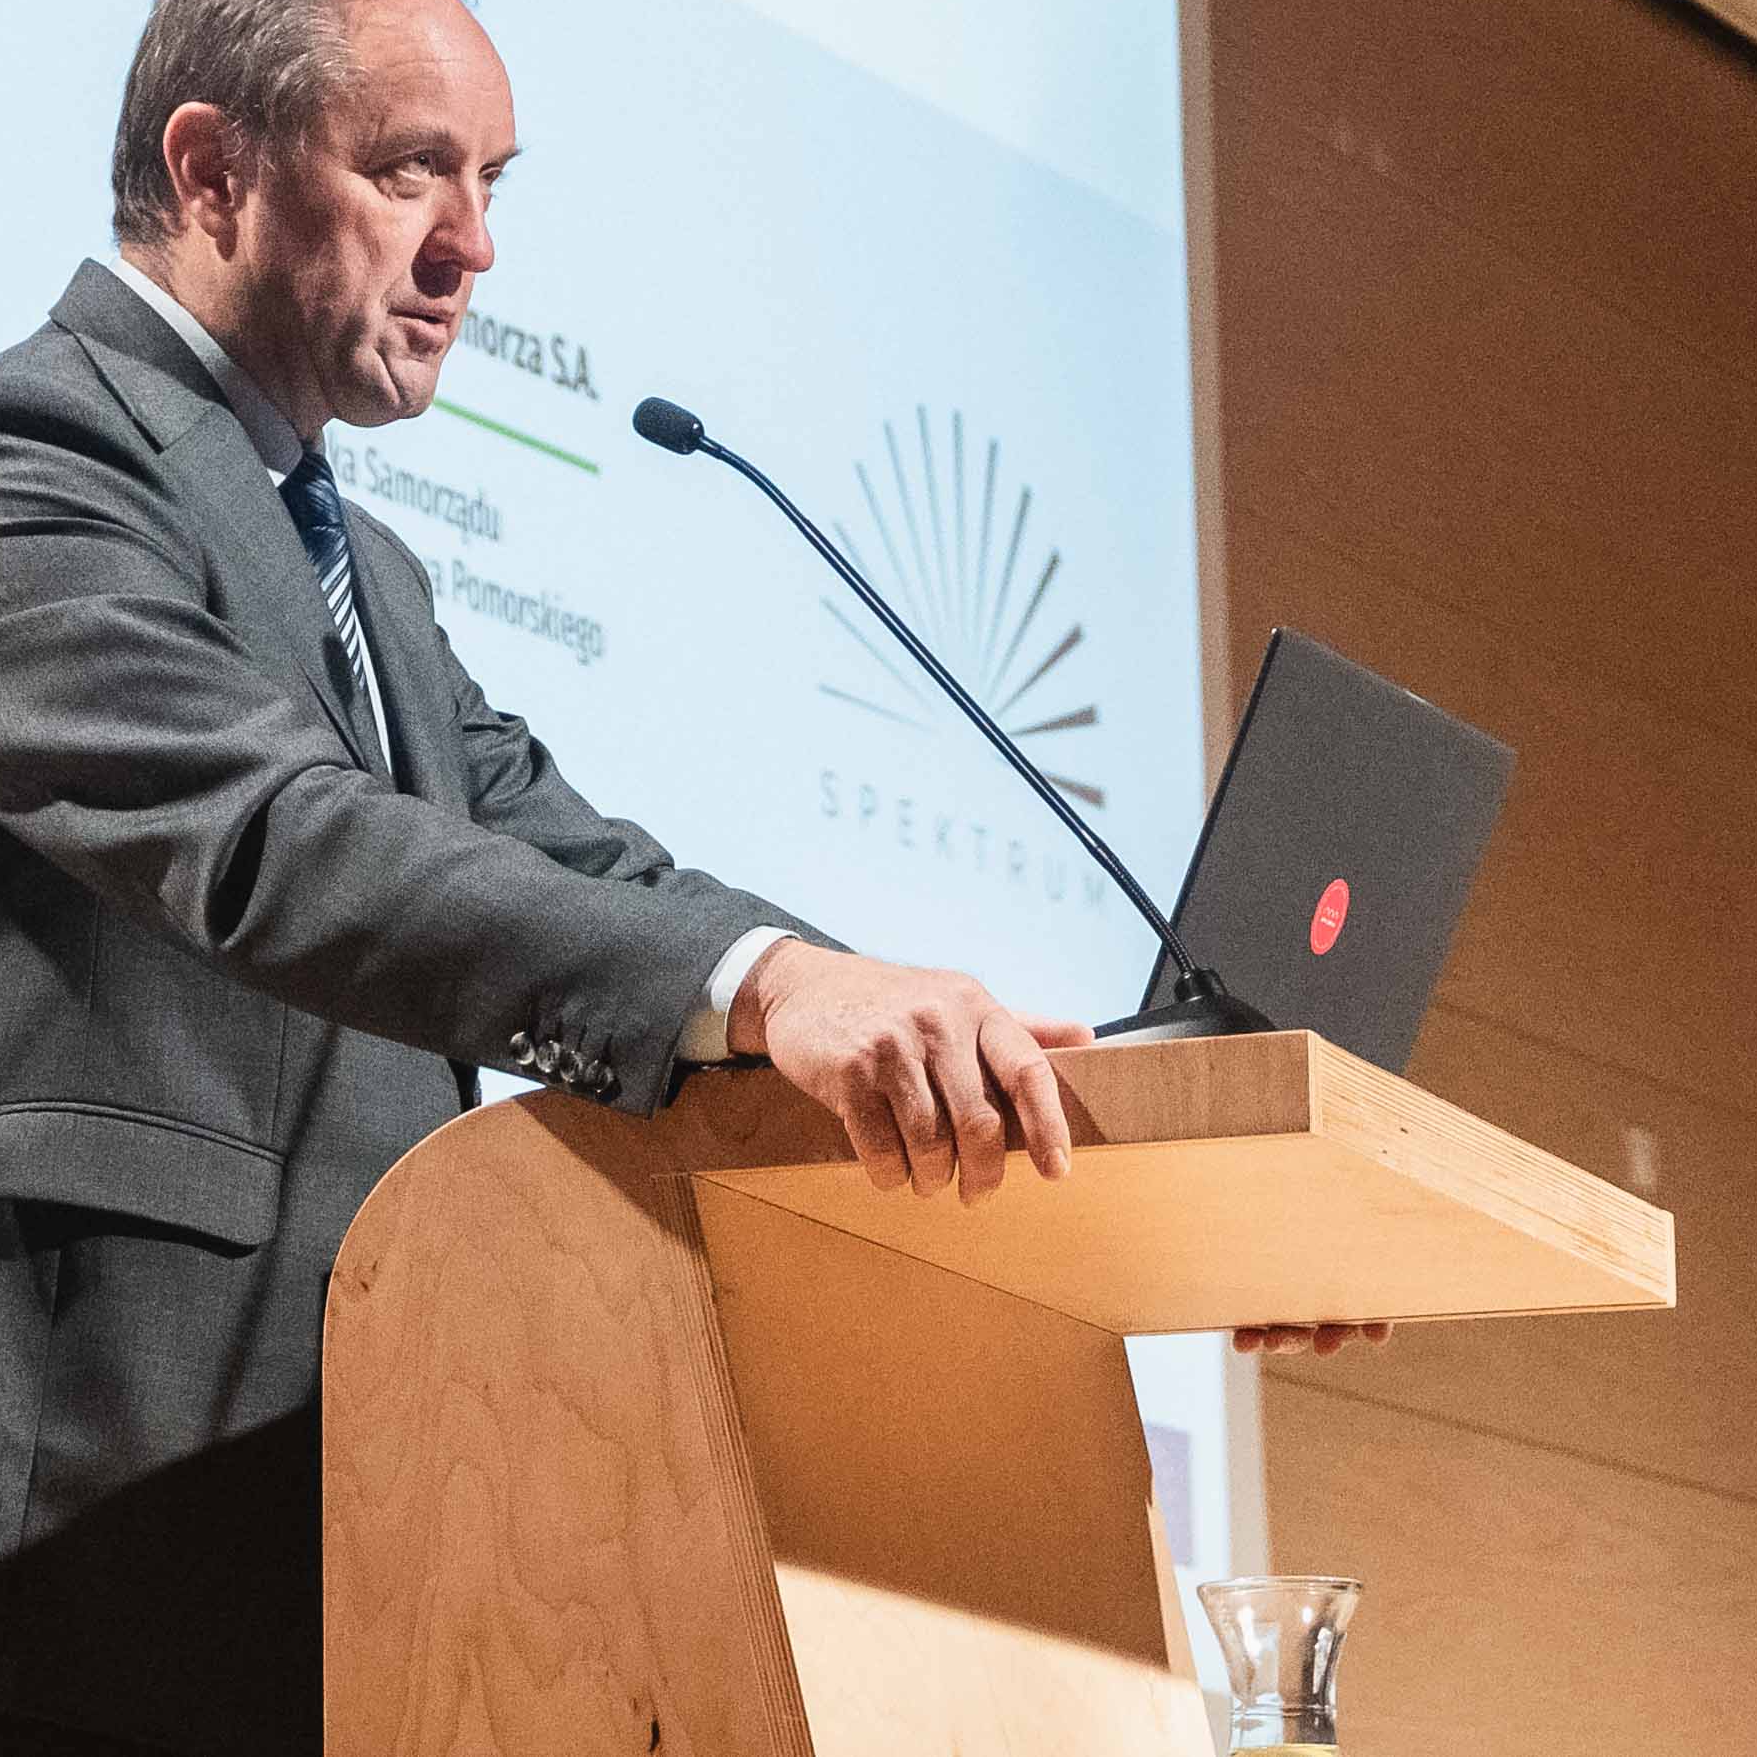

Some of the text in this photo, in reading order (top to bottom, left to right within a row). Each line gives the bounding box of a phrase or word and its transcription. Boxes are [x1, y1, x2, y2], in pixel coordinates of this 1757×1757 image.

[549, 334, 600, 401] S.A.
[364, 447, 502, 544] Samorządu
[452, 557, 605, 665] Pomorskiego
